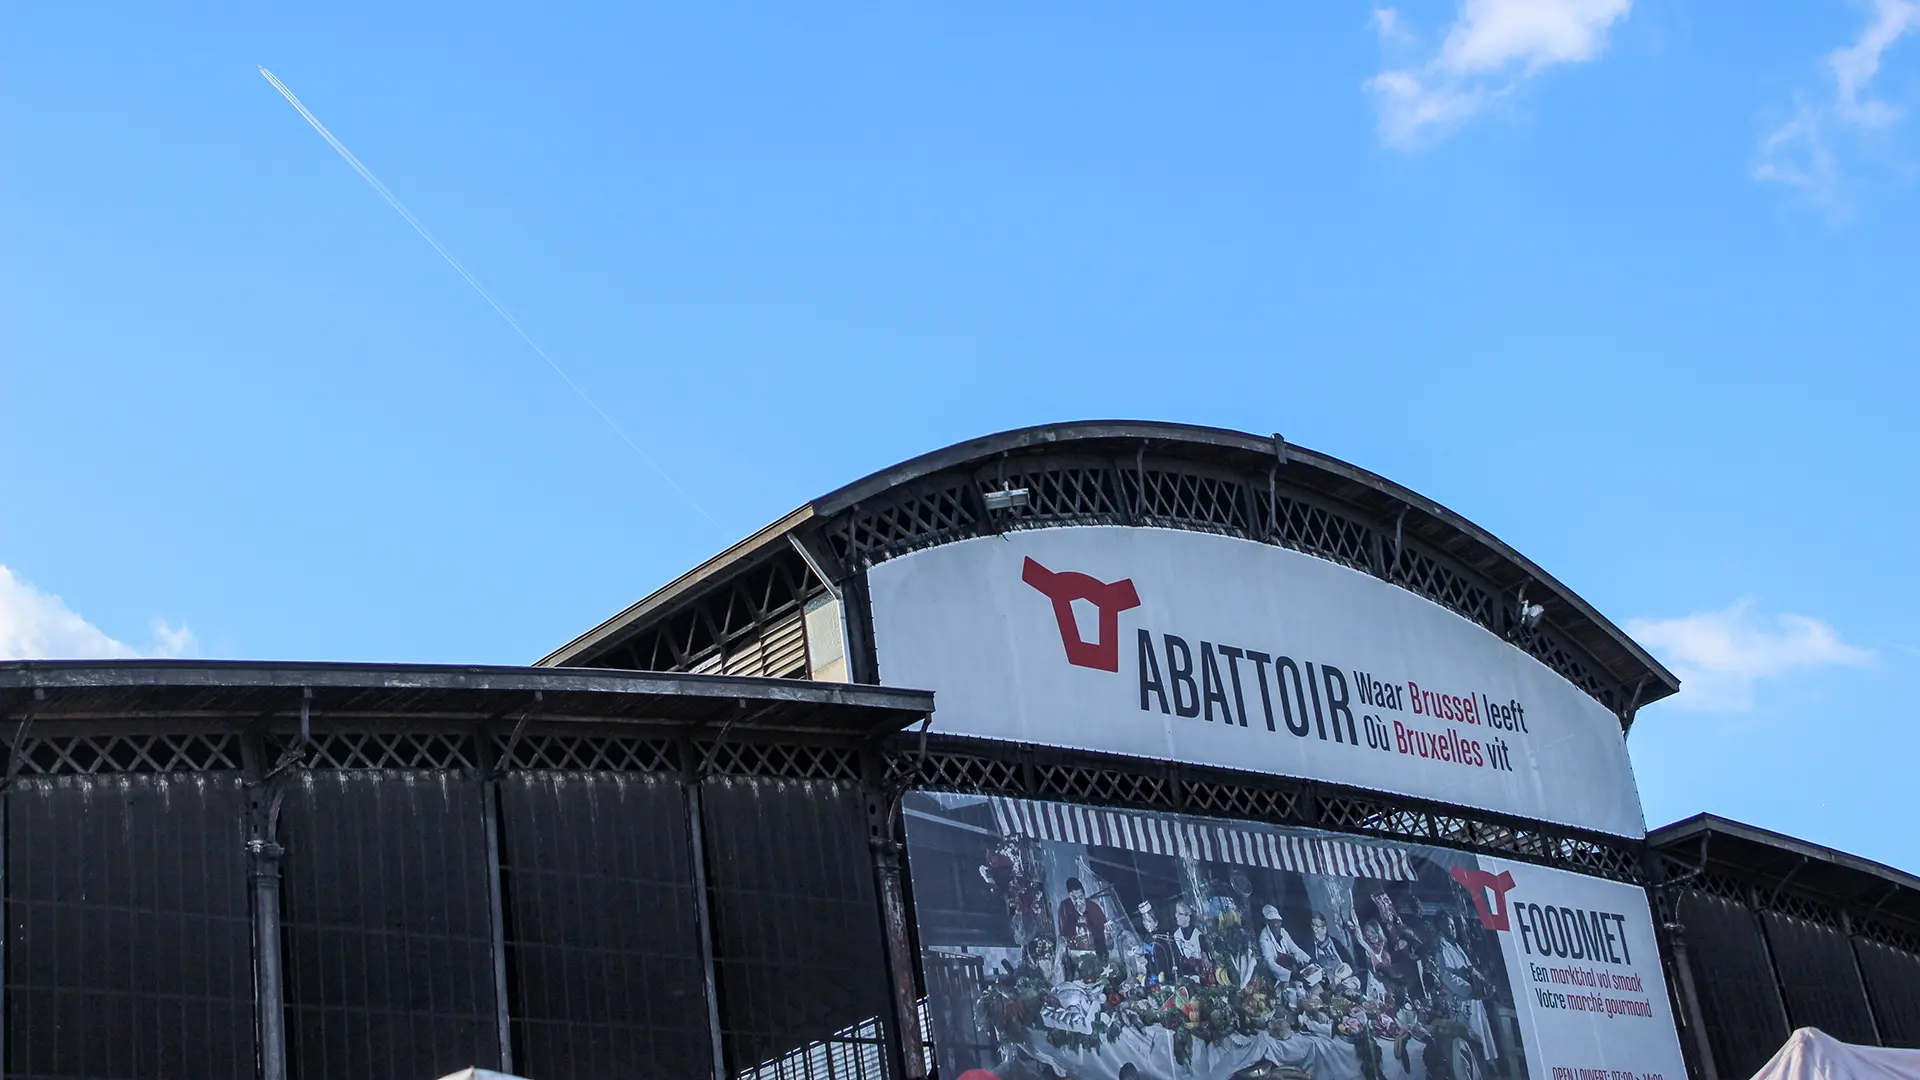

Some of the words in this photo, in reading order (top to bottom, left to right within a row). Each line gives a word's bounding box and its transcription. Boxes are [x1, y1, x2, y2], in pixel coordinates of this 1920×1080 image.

[1137, 628, 1359, 746] ABATTOIR
[1353, 670, 1403, 711] Waar
[1408, 681, 1481, 725] Brussel
[1483, 693, 1528, 734] leeft
[1363, 714, 1391, 751] Où
[1393, 720, 1484, 767] Bruxelles
[1486, 736, 1512, 772] vit
[1513, 902, 1632, 966] FOODMET
[1530, 962, 1549, 982] Een
[1550, 965, 1596, 987] markthal
[1597, 969, 1611, 989] vol
[1612, 973, 1644, 993] smaak
[1535, 988, 1566, 1010] Votre
[1567, 992, 1604, 1013] marché
[1605, 999, 1652, 1019] gourmand
[1552, 1067, 1572, 1080] OPEN
